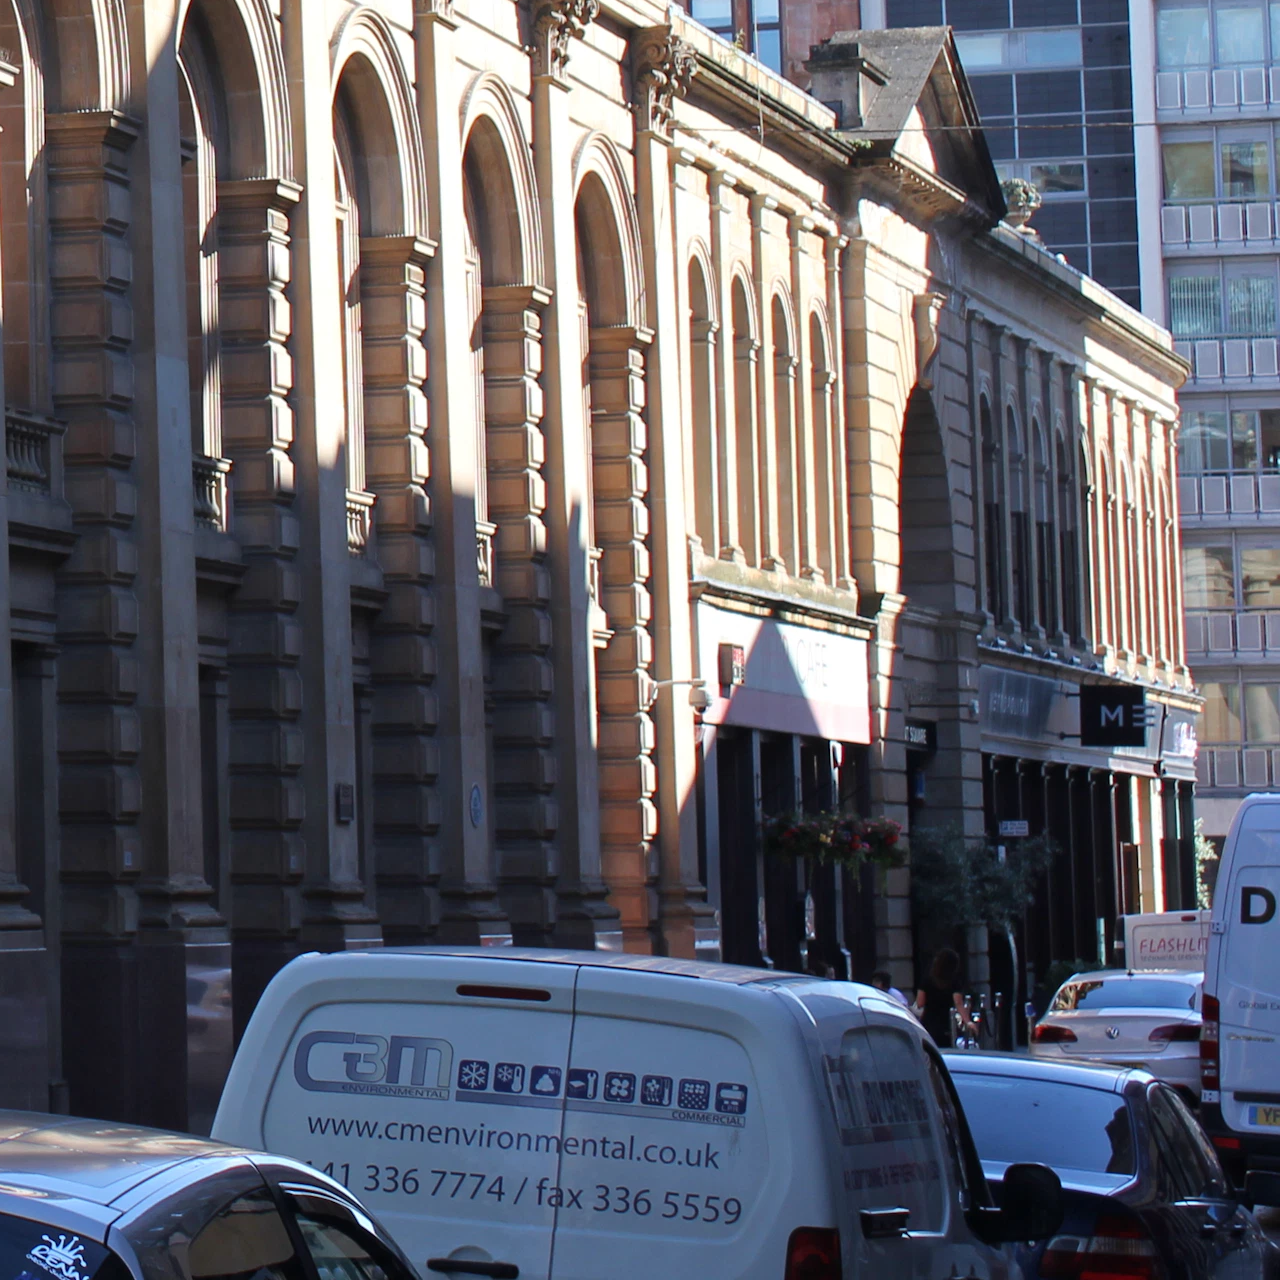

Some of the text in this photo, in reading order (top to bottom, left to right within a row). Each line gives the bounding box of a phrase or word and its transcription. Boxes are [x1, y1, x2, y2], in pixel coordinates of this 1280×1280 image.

[1240, 886, 1277, 925] D
[1238, 1000, 1268, 1010] Global
[341, 1084, 447, 1100] ENVIRONMENTAL
[671, 1110, 743, 1127] COMMERCIAL
[308, 1115, 720, 1170] www.cmenvironmental.co.uk
[363, 1164, 420, 1196] 336
[430, 1169, 506, 1203] 7774
[513, 1176, 528, 1206] /
[536, 1176, 583, 1211] fax
[592, 1183, 656, 1219] 336
[661, 1191, 742, 1226] 5559
